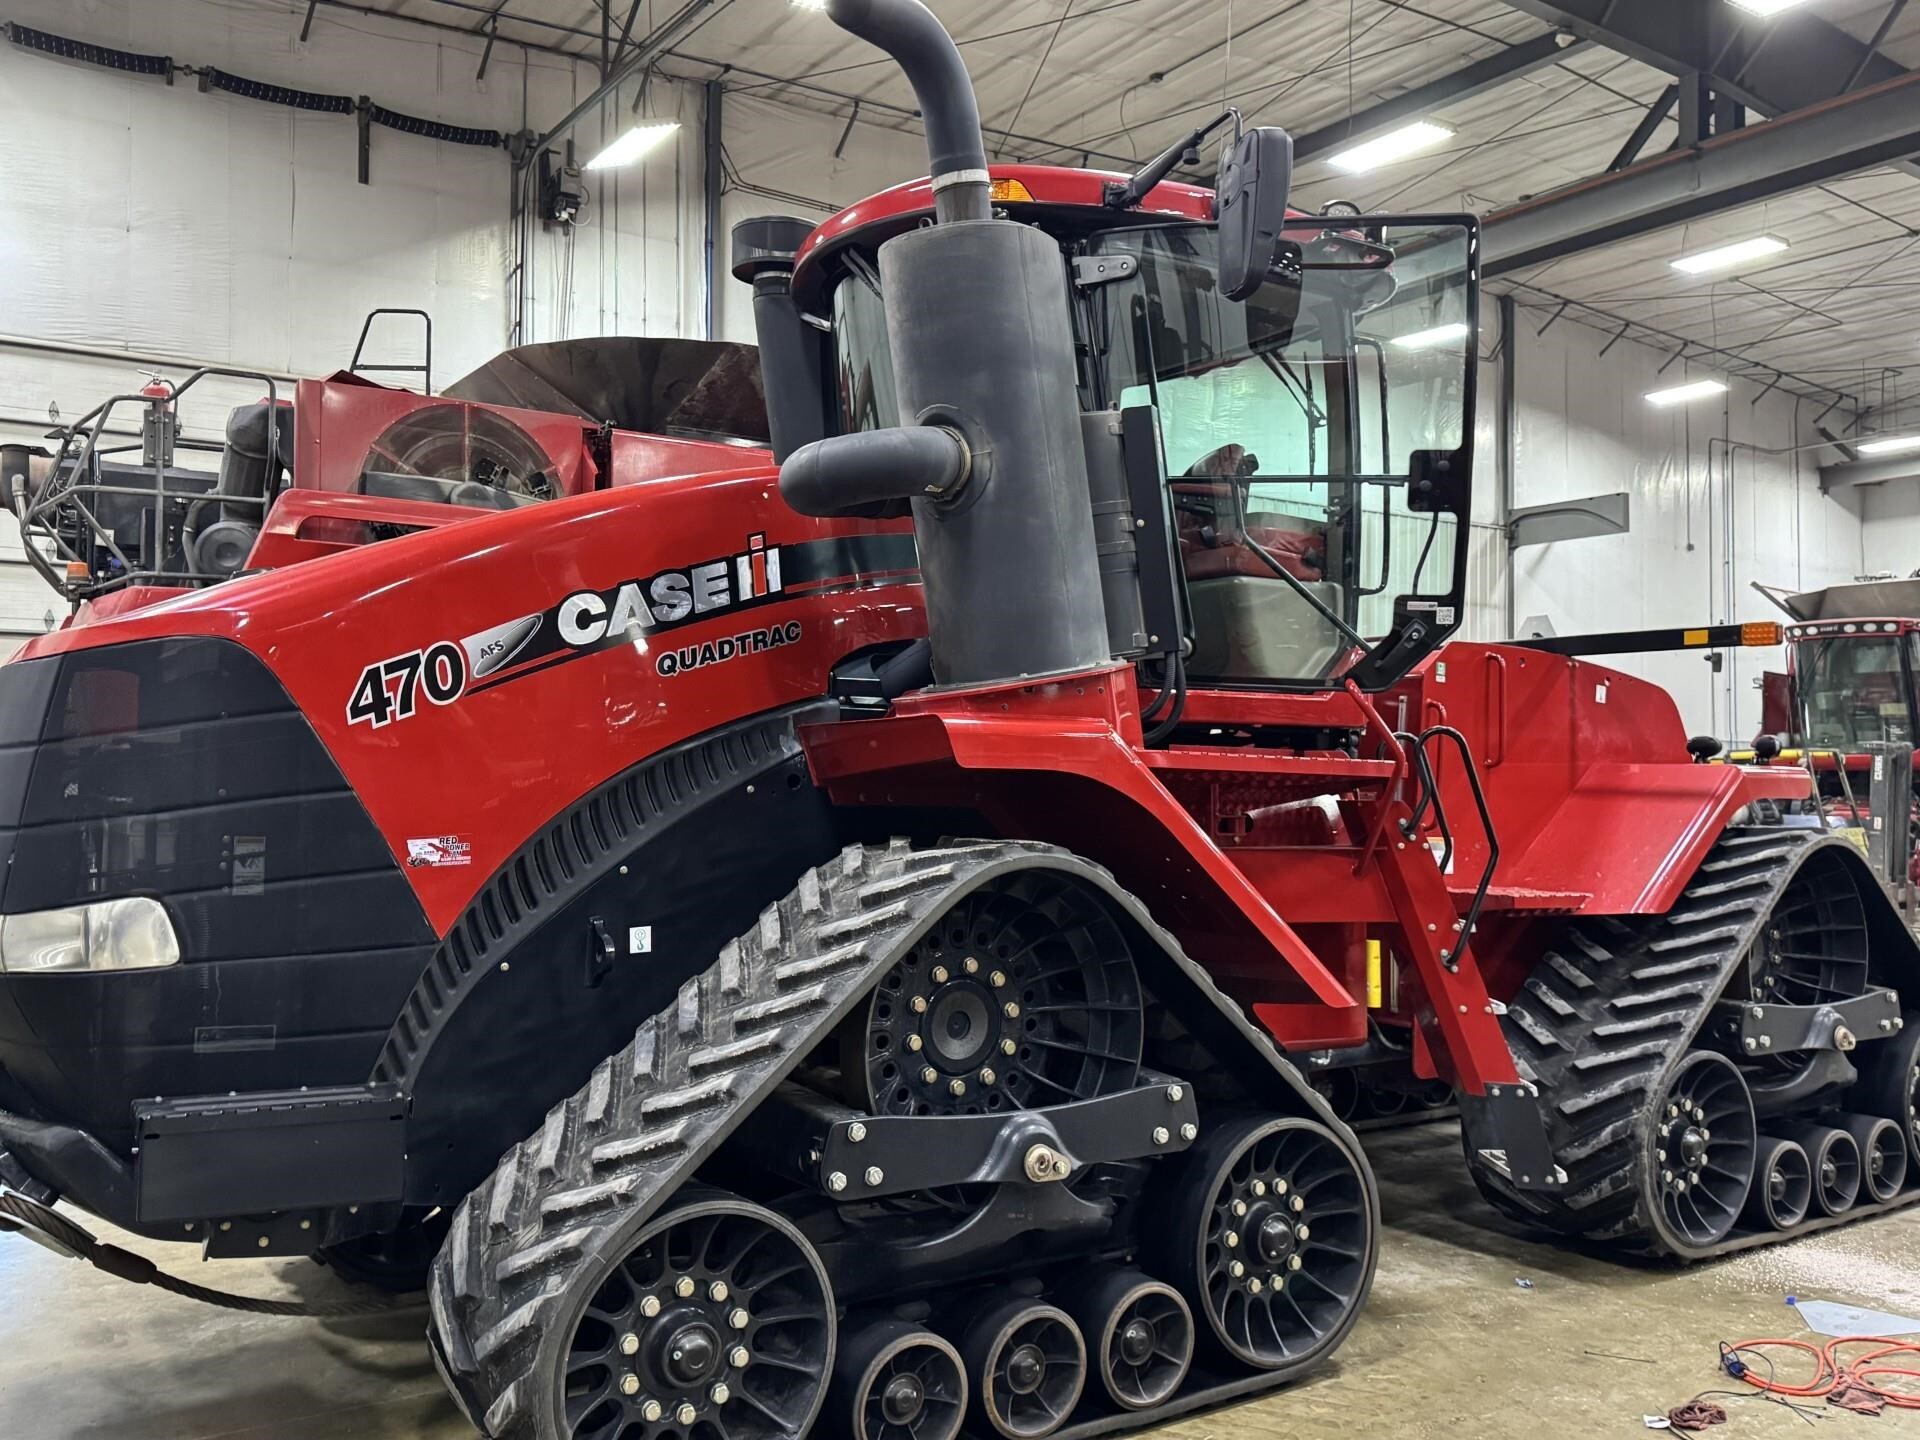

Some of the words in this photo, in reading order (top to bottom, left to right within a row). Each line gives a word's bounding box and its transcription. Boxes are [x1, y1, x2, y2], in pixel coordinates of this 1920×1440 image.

[557, 561, 731, 646] CASE
[480, 640, 505, 659] AFS
[656, 621, 802, 677] QUADTRAC
[346, 640, 466, 729] 470
[439, 836, 458, 845] RED
